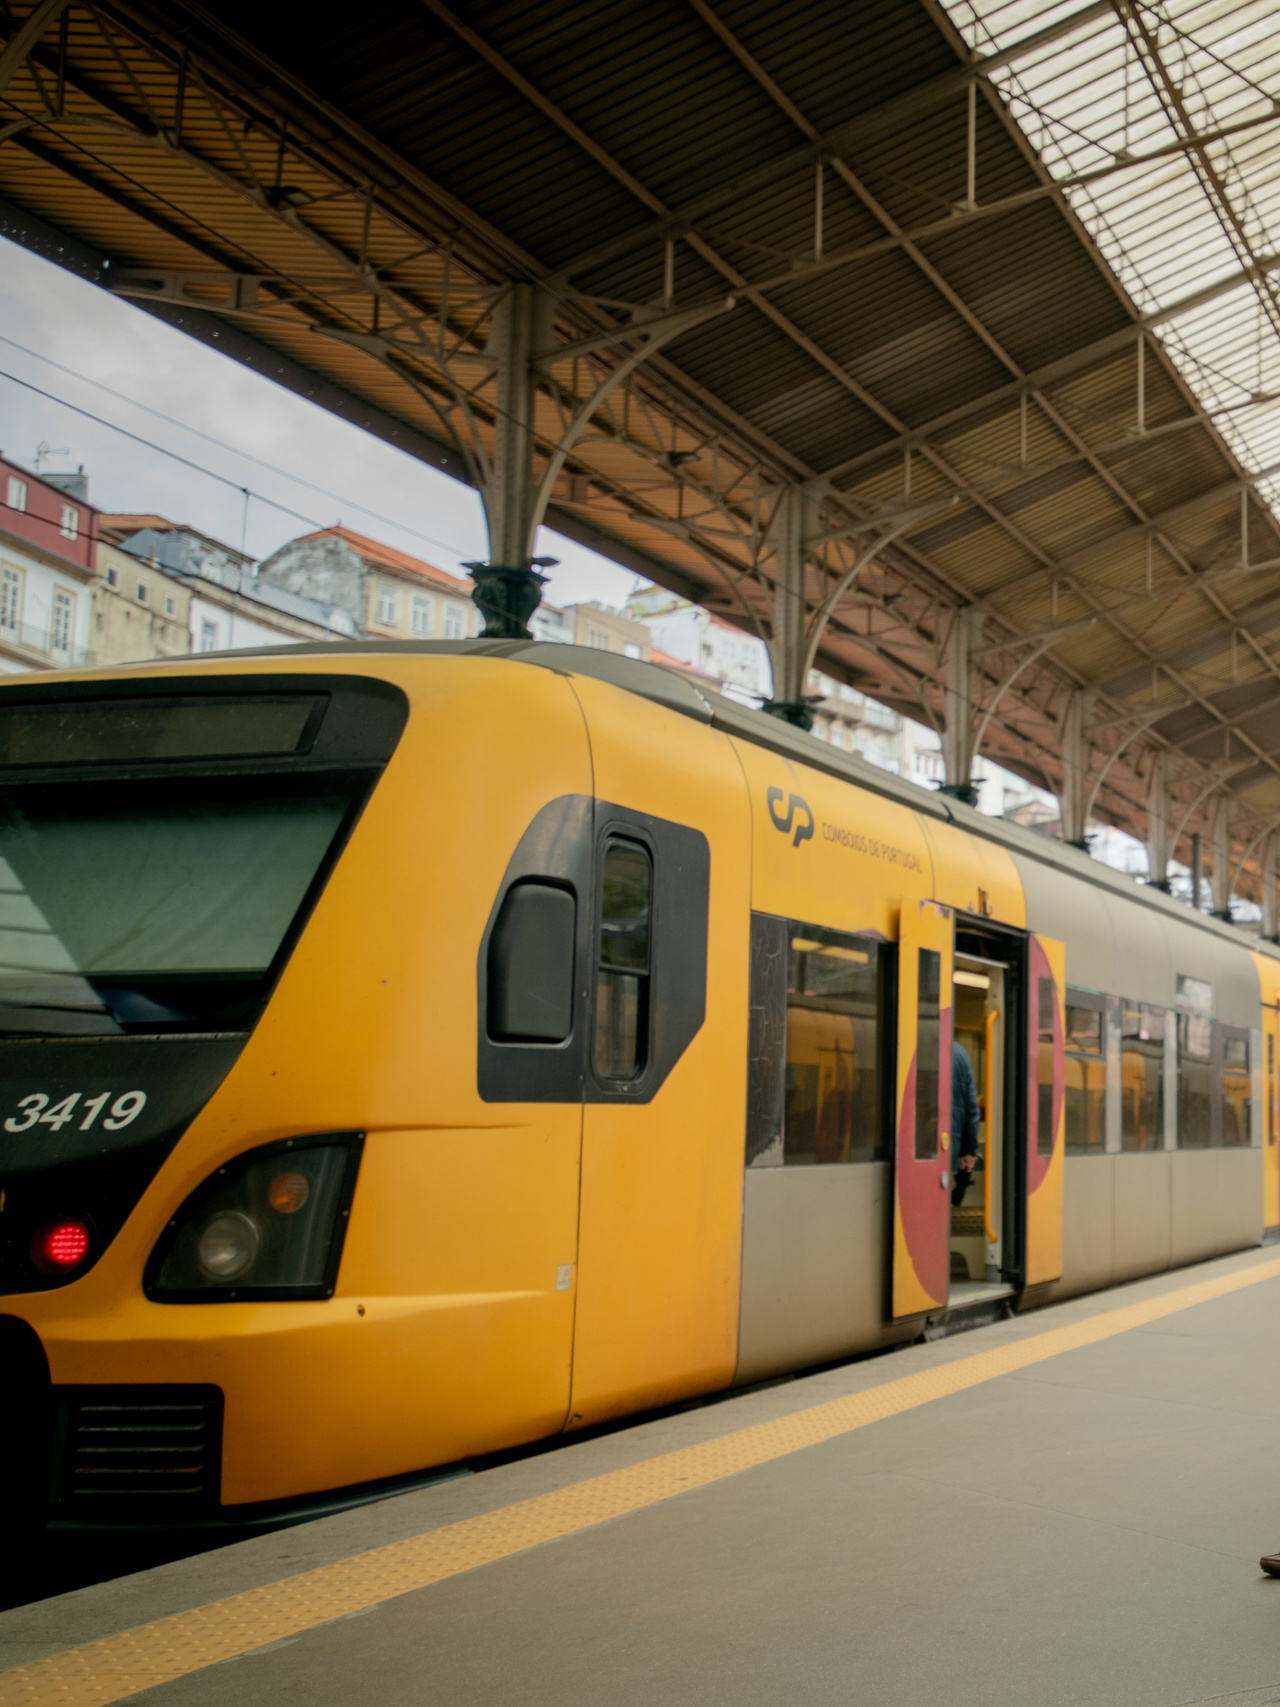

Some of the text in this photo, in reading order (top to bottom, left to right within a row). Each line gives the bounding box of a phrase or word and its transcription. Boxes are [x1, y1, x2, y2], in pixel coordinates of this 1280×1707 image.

[822, 822, 923, 873] COMBOIOS DE PORTUGAL
[4, 1090, 147, 1133] 3419
